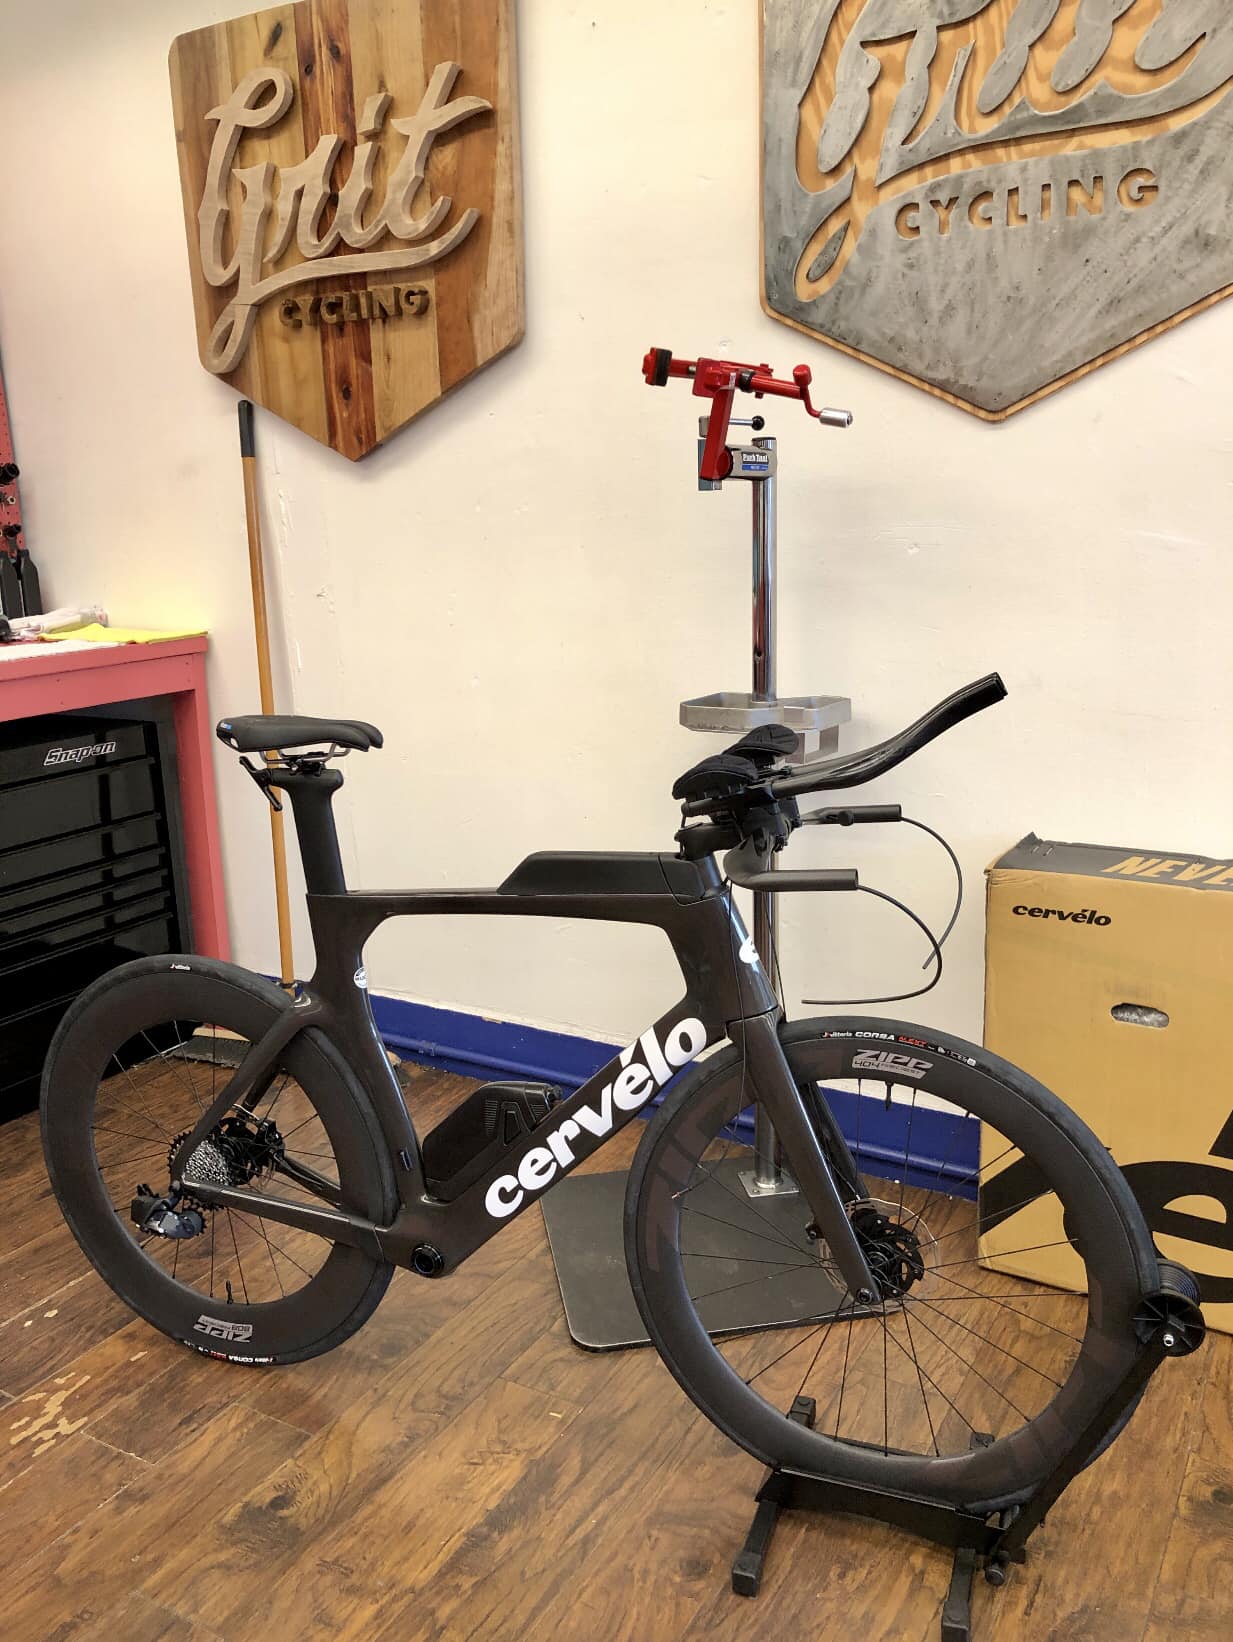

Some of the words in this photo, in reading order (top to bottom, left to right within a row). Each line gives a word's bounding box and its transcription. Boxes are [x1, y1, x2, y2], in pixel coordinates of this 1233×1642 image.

[895, 167, 1159, 240] CYCLING
[199, 61, 493, 374] Grit
[279, 285, 430, 329] CYCLING
[44, 742, 116, 766] Snap-on
[1012, 905, 1112, 927] cervélo
[855, 1031, 895, 1041] CORSA
[854, 1049, 934, 1070] ZIPP
[854, 1060, 880, 1069] 404
[485, 1017, 707, 1218] cervélo
